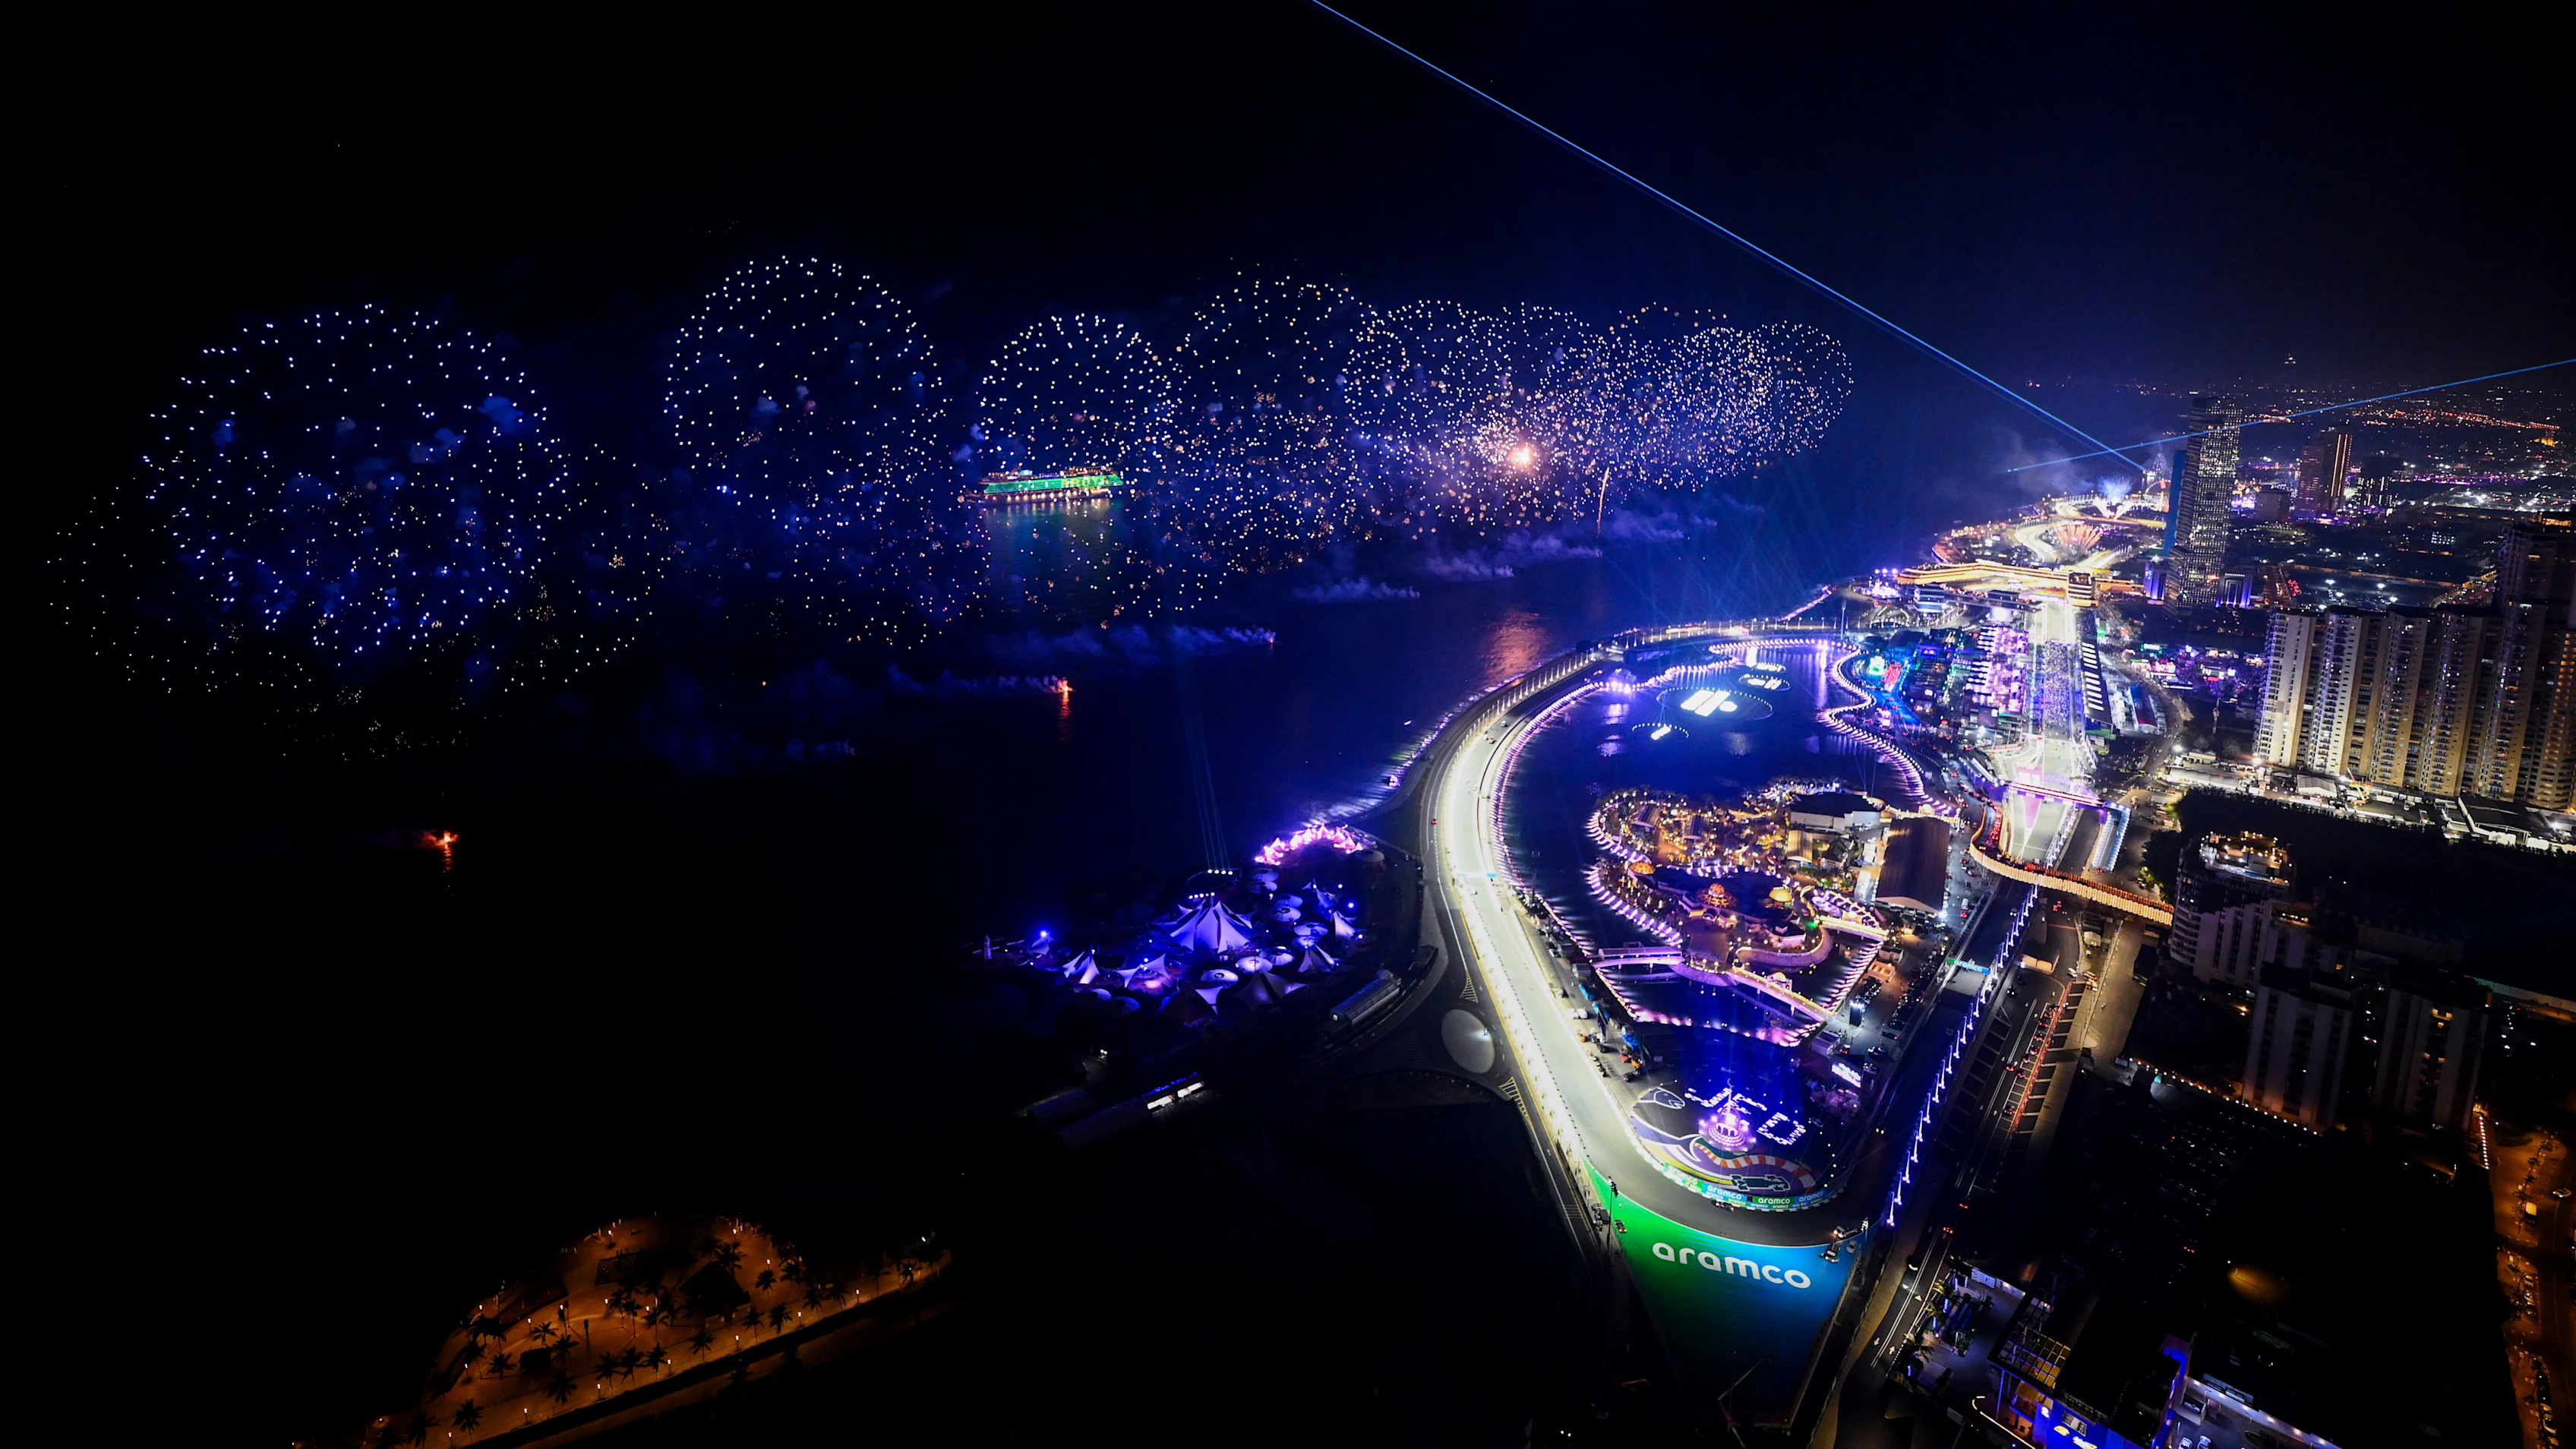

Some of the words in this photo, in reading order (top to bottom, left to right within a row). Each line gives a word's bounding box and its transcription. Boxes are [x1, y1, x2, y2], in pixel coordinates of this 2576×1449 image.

[1954, 960, 1983, 972] aramco
[1707, 1185, 1742, 1200] aramco
[1799, 1190, 1824, 1202] aramco
[1652, 1242, 1811, 1289] aramco
